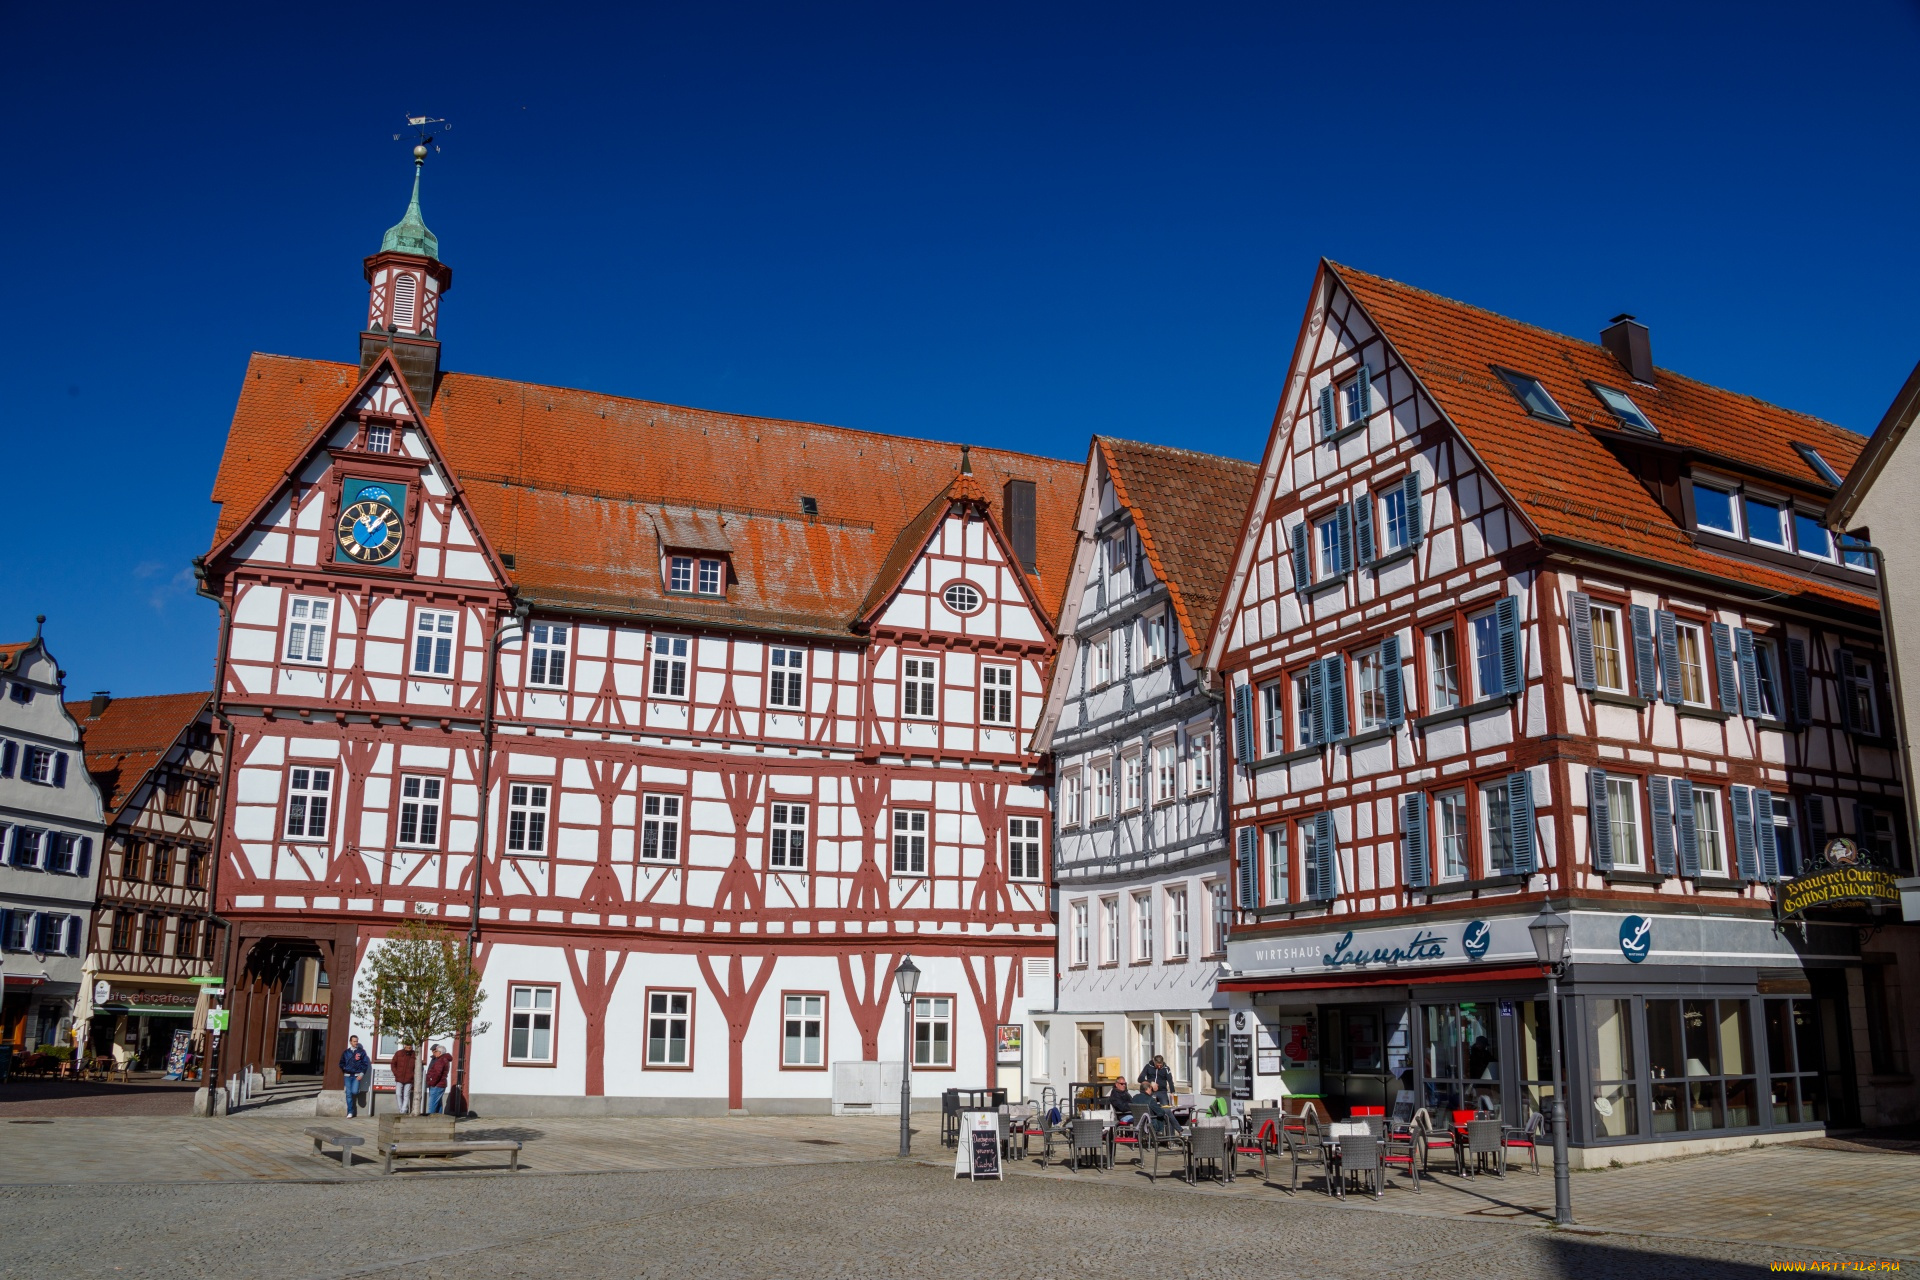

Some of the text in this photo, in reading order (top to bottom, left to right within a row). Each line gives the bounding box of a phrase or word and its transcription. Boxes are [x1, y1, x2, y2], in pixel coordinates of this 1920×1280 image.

[1846, 868, 1905, 885] Quenze
[1255, 930, 1448, 966] WIRTSHAUS Laurentia
[281, 1003, 328, 1013] CHUMAC
